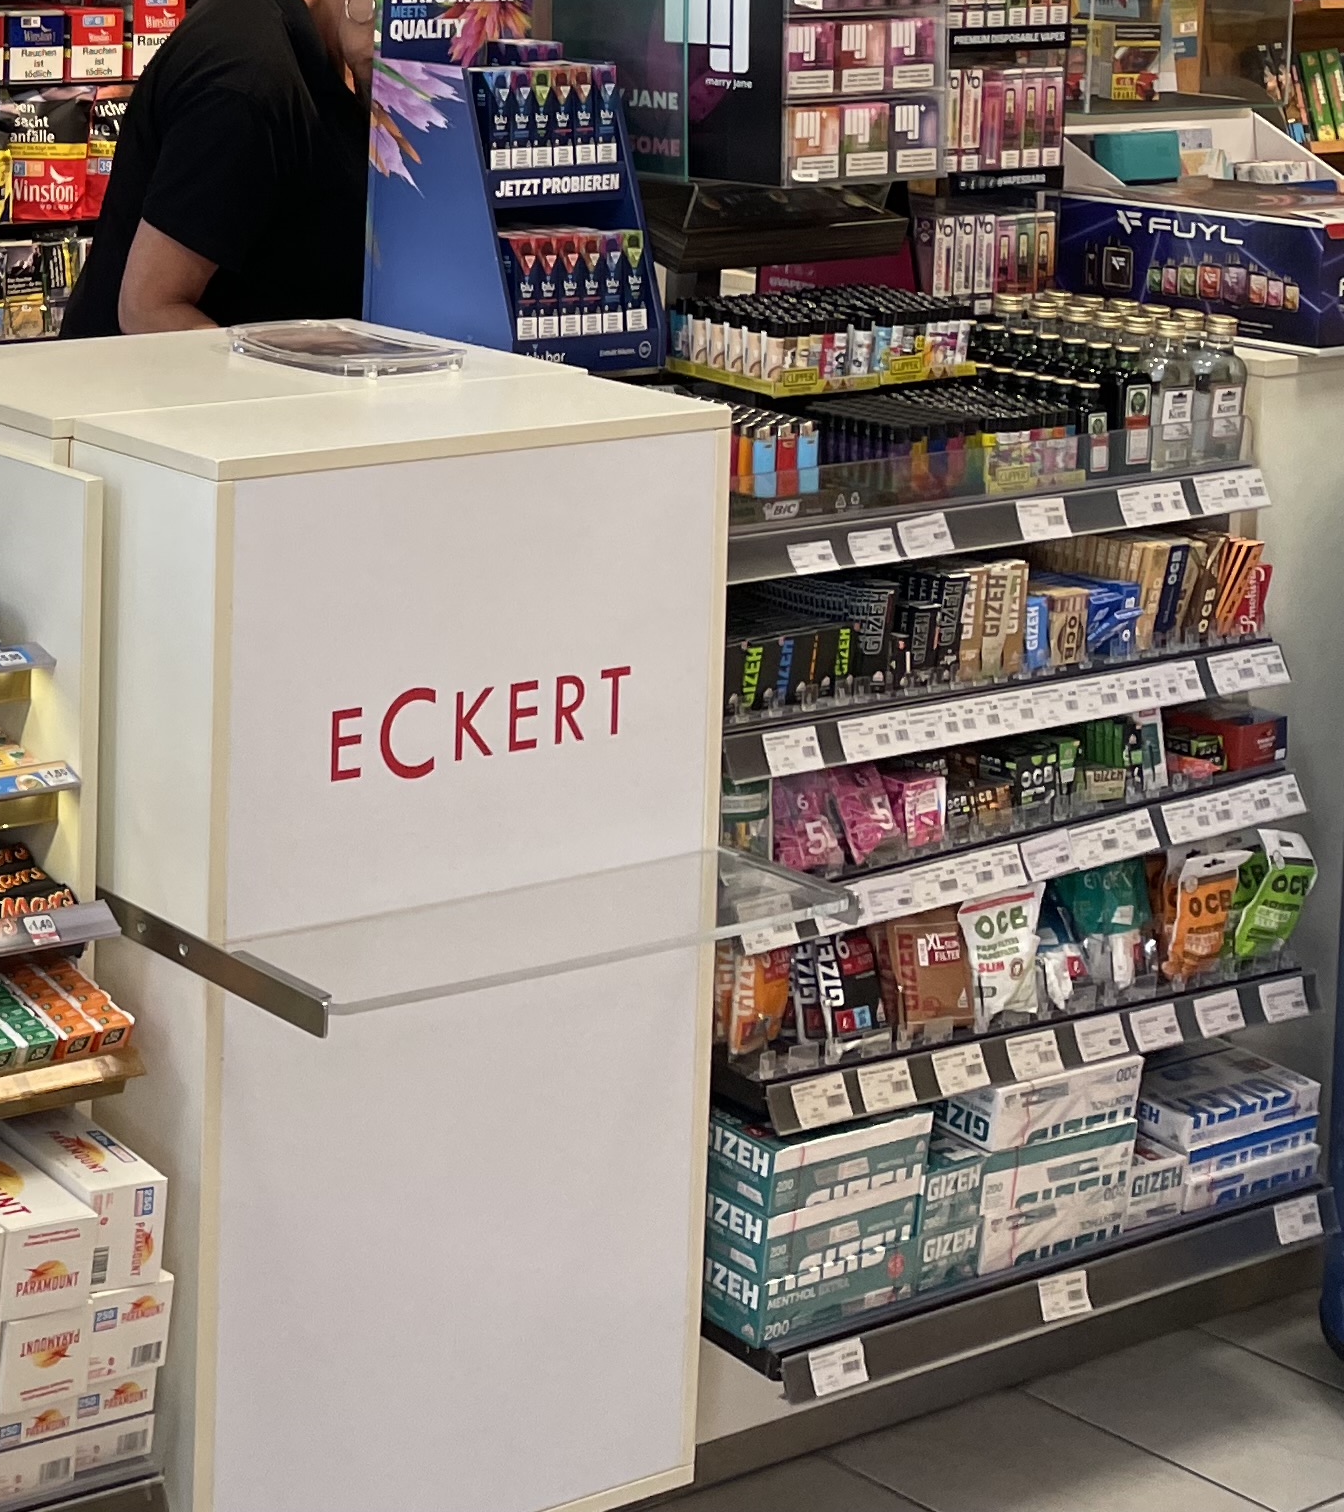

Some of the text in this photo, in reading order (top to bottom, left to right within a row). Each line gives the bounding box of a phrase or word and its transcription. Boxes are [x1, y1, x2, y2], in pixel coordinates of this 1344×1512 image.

[390, 5, 427, 18] MEETS
[389, 18, 467, 41] QUALITY
[630, 90, 679, 110] JANE
[10, 130, 55, 143] anfälle
[11, 178, 78, 204] Winston
[495, 174, 620, 198] JETZT PROBIEREN
[1149, 217, 1244, 245] FUYL
[1240, 566, 1265, 633] Smoking
[330, 665, 632, 783] ECKERT
[1020, 763, 1056, 788] OCB
[1188, 895, 1233, 917] OCB
[974, 904, 1029, 942] OCB
[927, 1164, 981, 1201] GIZEH
